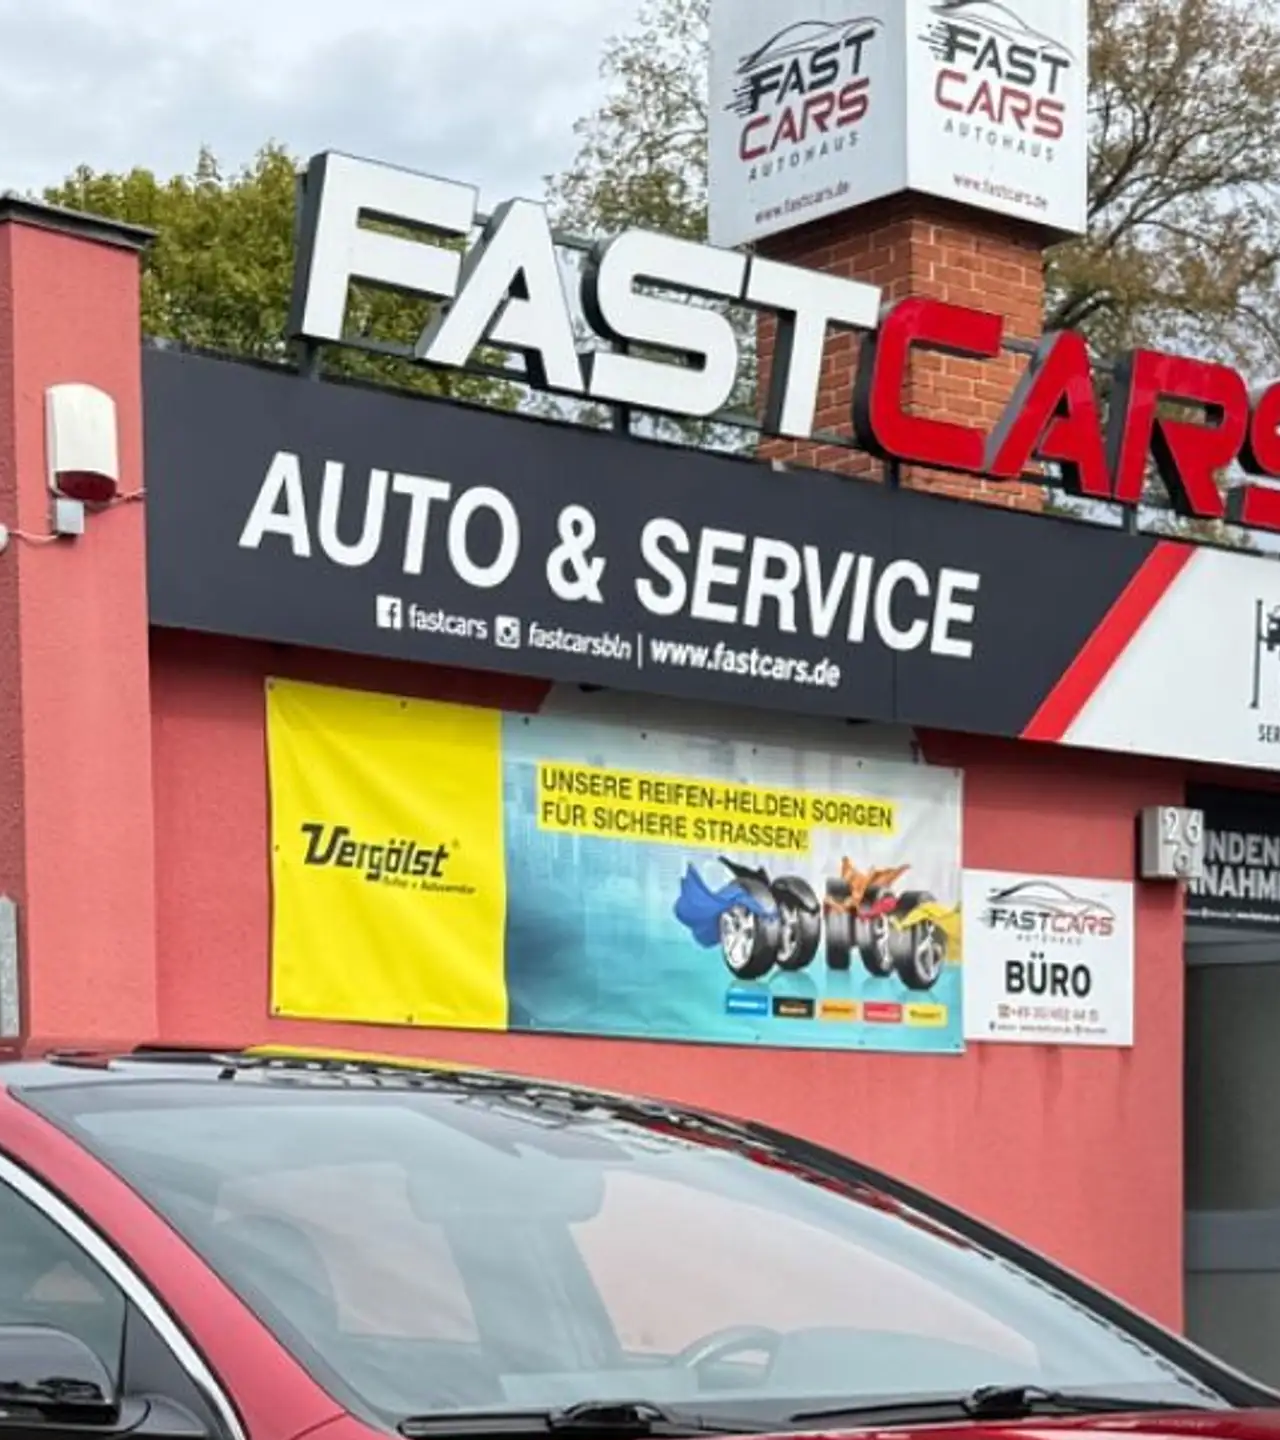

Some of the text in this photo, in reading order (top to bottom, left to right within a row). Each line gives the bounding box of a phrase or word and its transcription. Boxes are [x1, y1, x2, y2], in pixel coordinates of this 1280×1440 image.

[746, 28, 876, 112] FAST
[942, 23, 1071, 95] FAST
[738, 76, 871, 162] CARS
[934, 68, 1065, 141] CARS
[747, 130, 861, 184] AUTOHAUS
[942, 118, 1056, 163] AUTOHAUS
[754, 180, 851, 225] www.fastcars.de
[951, 172, 1049, 212] www.fastcars.de
[238, 450, 982, 660] AUTO & SERVICE
[408, 603, 841, 689] fastcars fastcarsbln www.fastcars.de
[540, 766, 893, 829] UNSERE REIFEN-HELDEN SORGEN
[541, 796, 809, 850] FÜR SICHERE STRASSEN!
[1161, 806, 1202, 848] 26
[300, 822, 450, 883] Vergölst
[1004, 950, 1092, 999] BÜRO
